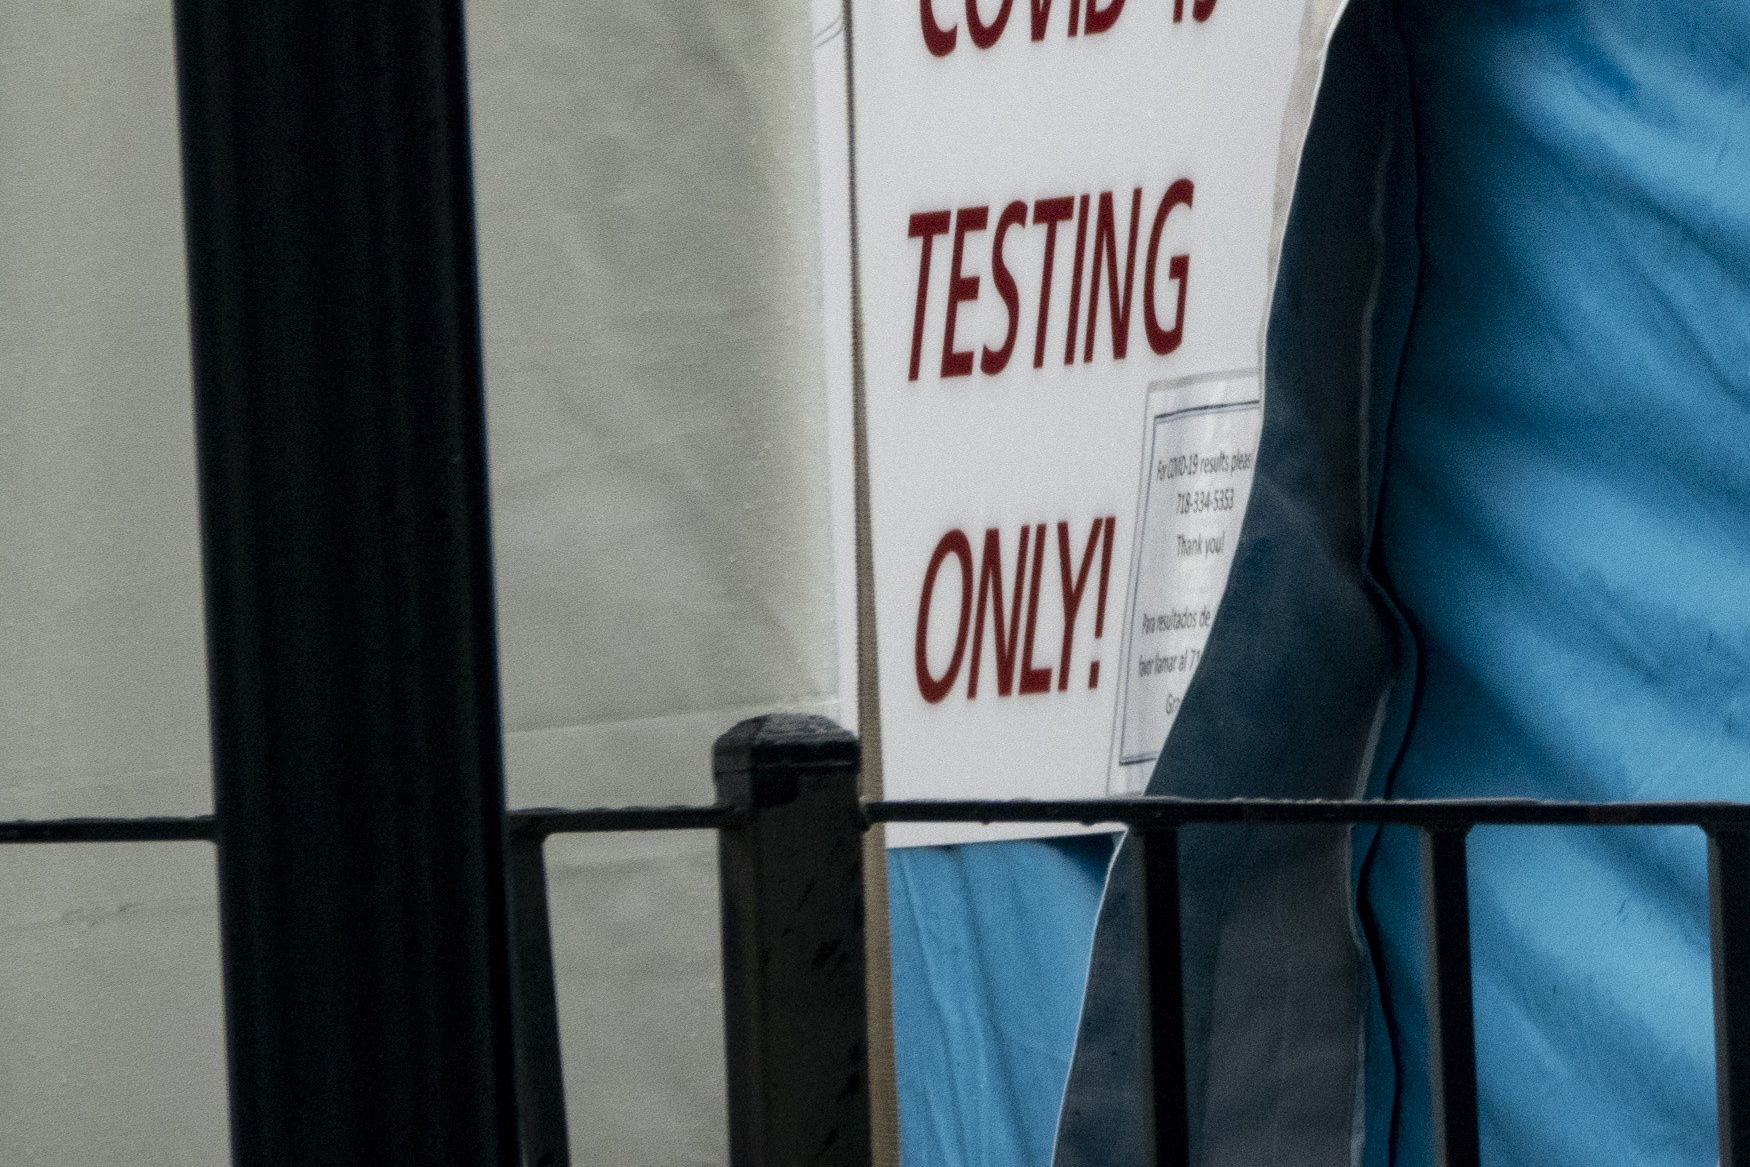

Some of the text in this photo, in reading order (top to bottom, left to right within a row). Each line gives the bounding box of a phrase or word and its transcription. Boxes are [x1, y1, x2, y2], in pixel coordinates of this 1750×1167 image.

[908, 178, 1195, 382] TESTING
[1200, 450, 1229, 474] results
[1177, 530, 1226, 559] Thank you!
[914, 515, 1116, 705] ONLY!
[1199, 604, 1211, 628] de
